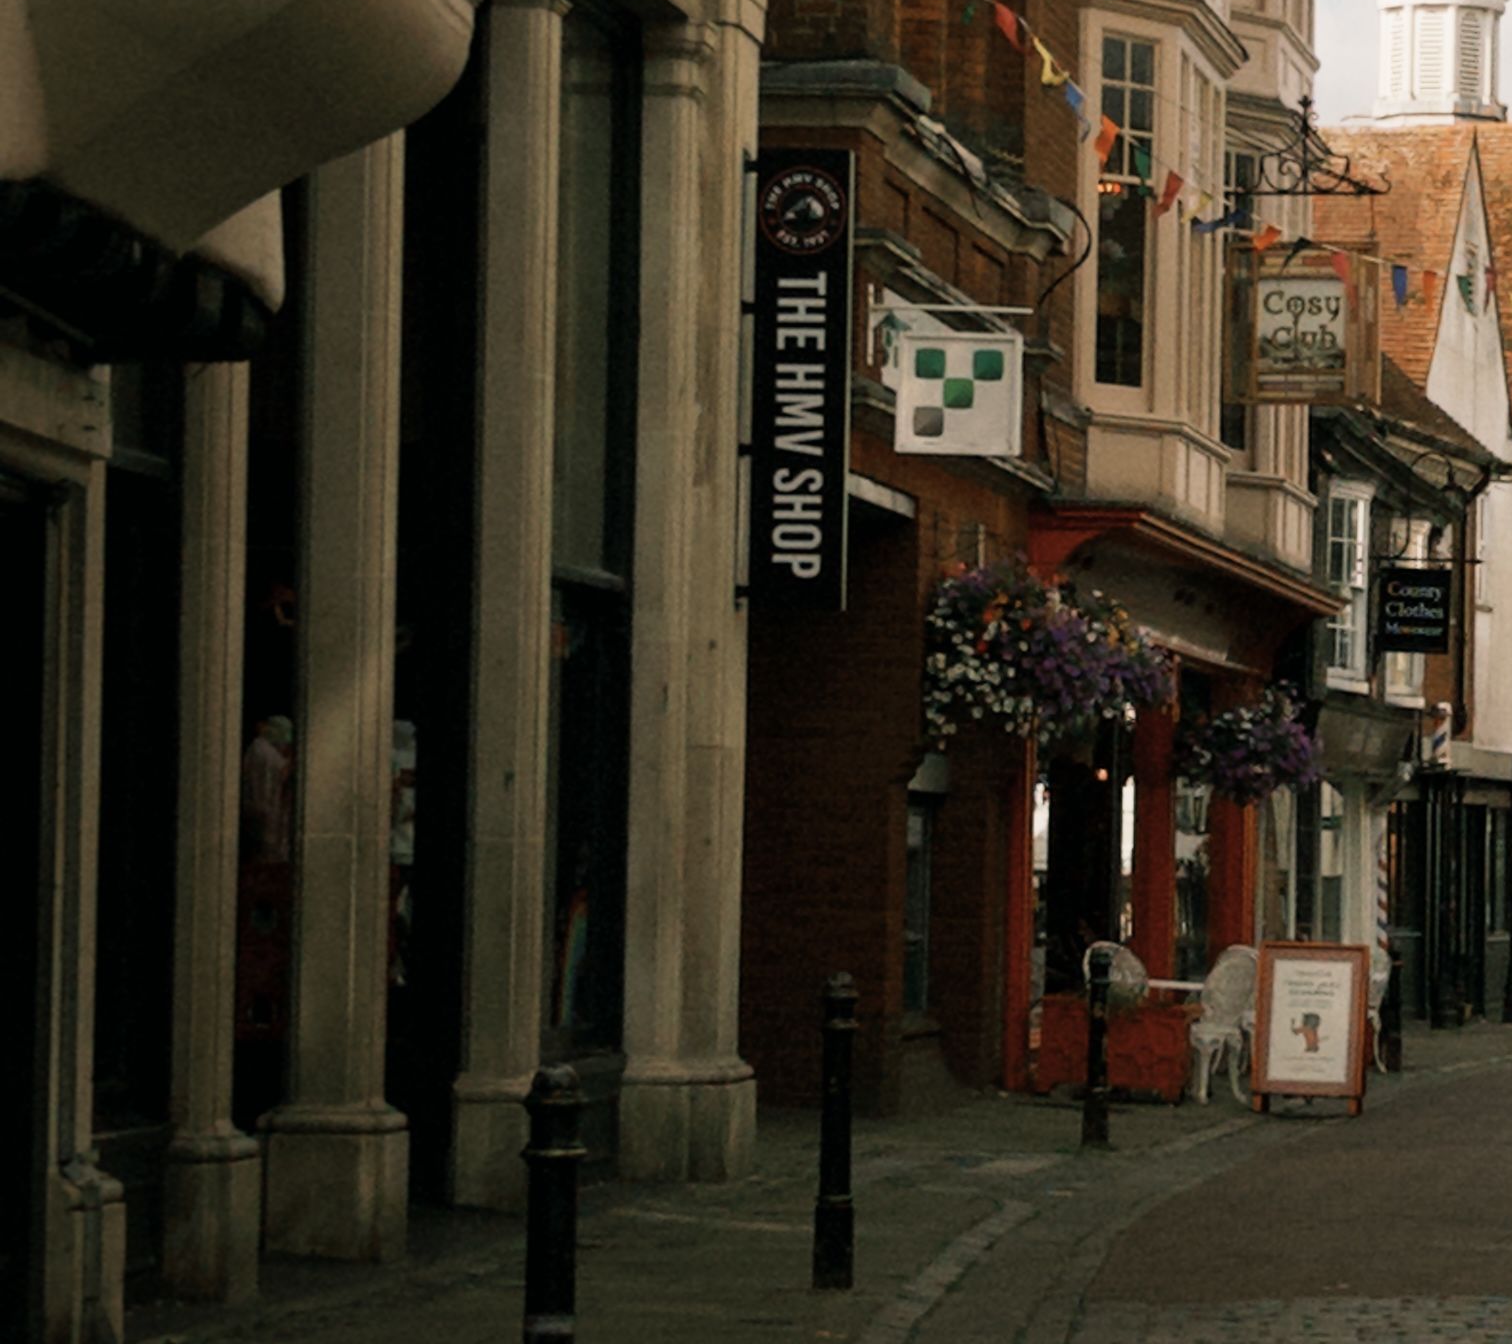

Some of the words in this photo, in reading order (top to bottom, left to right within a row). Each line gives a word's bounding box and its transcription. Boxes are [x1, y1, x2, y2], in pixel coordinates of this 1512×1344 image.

[775, 270, 828, 352] THE
[1263, 290, 1342, 322] Cosy
[1271, 322, 1337, 353] Club
[773, 362, 826, 457] HMV
[770, 468, 825, 580] SHOP
